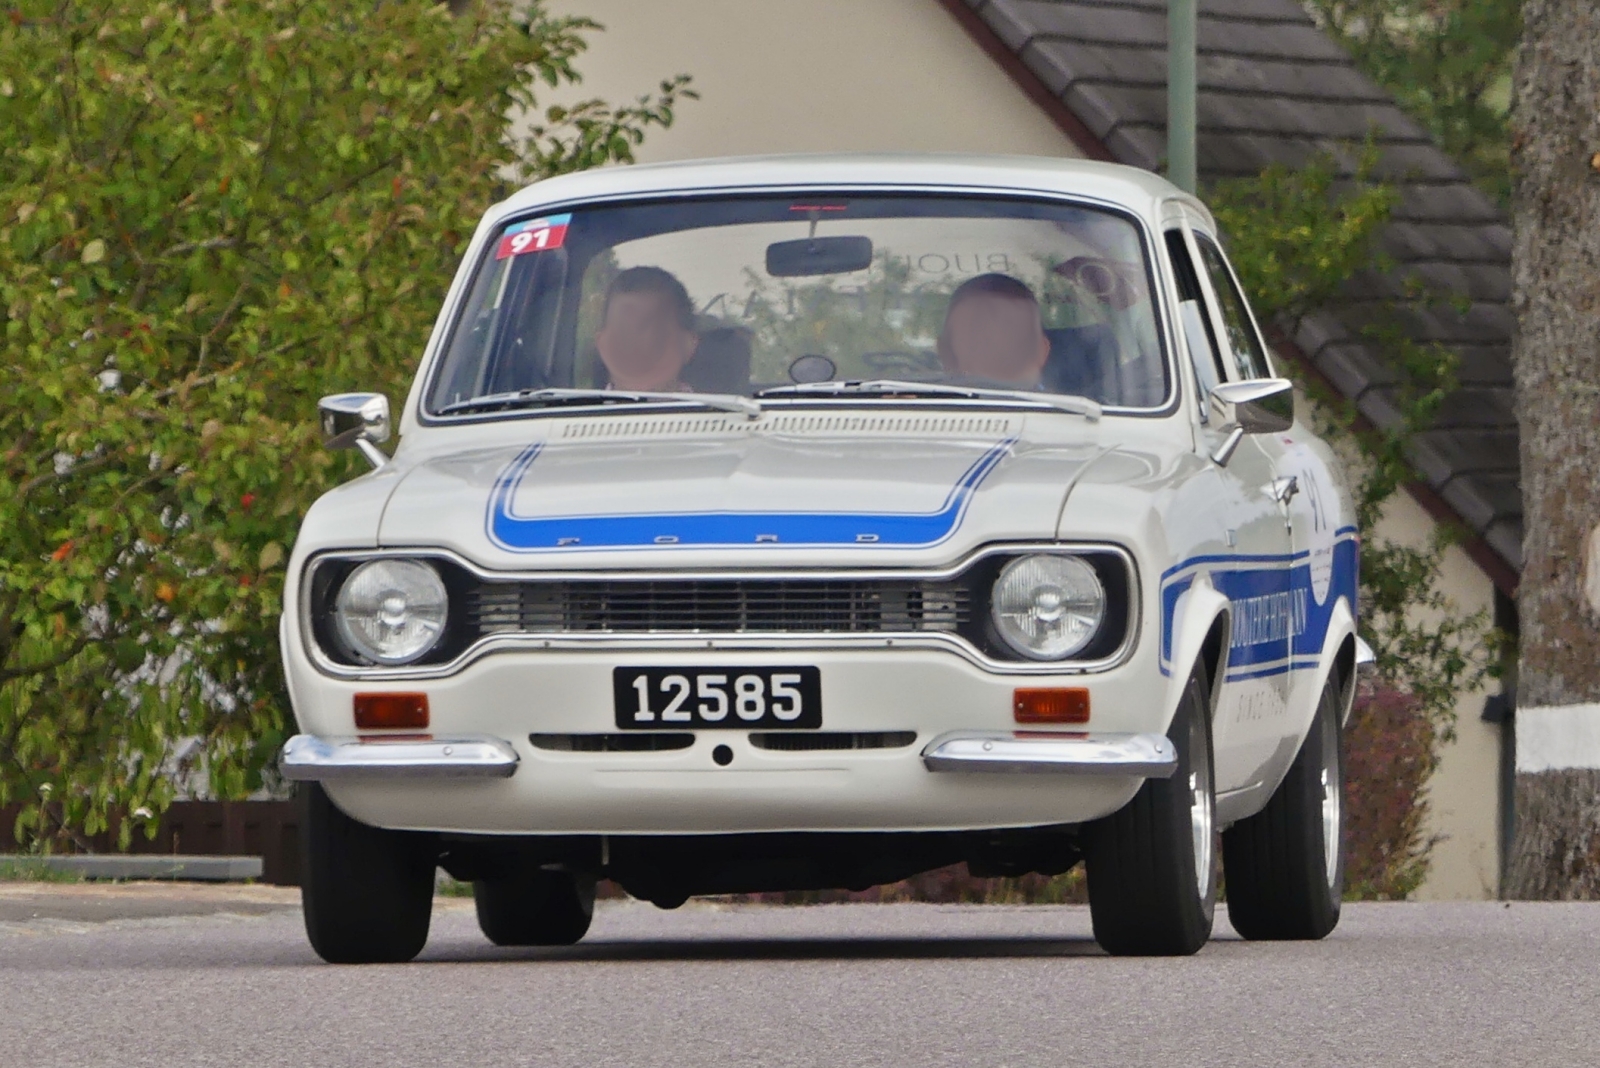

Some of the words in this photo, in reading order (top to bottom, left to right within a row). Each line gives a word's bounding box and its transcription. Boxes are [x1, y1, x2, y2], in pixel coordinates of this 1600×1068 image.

[511, 228, 550, 252] 91
[556, 533, 880, 546] FORD
[632, 673, 803, 722] 12585
